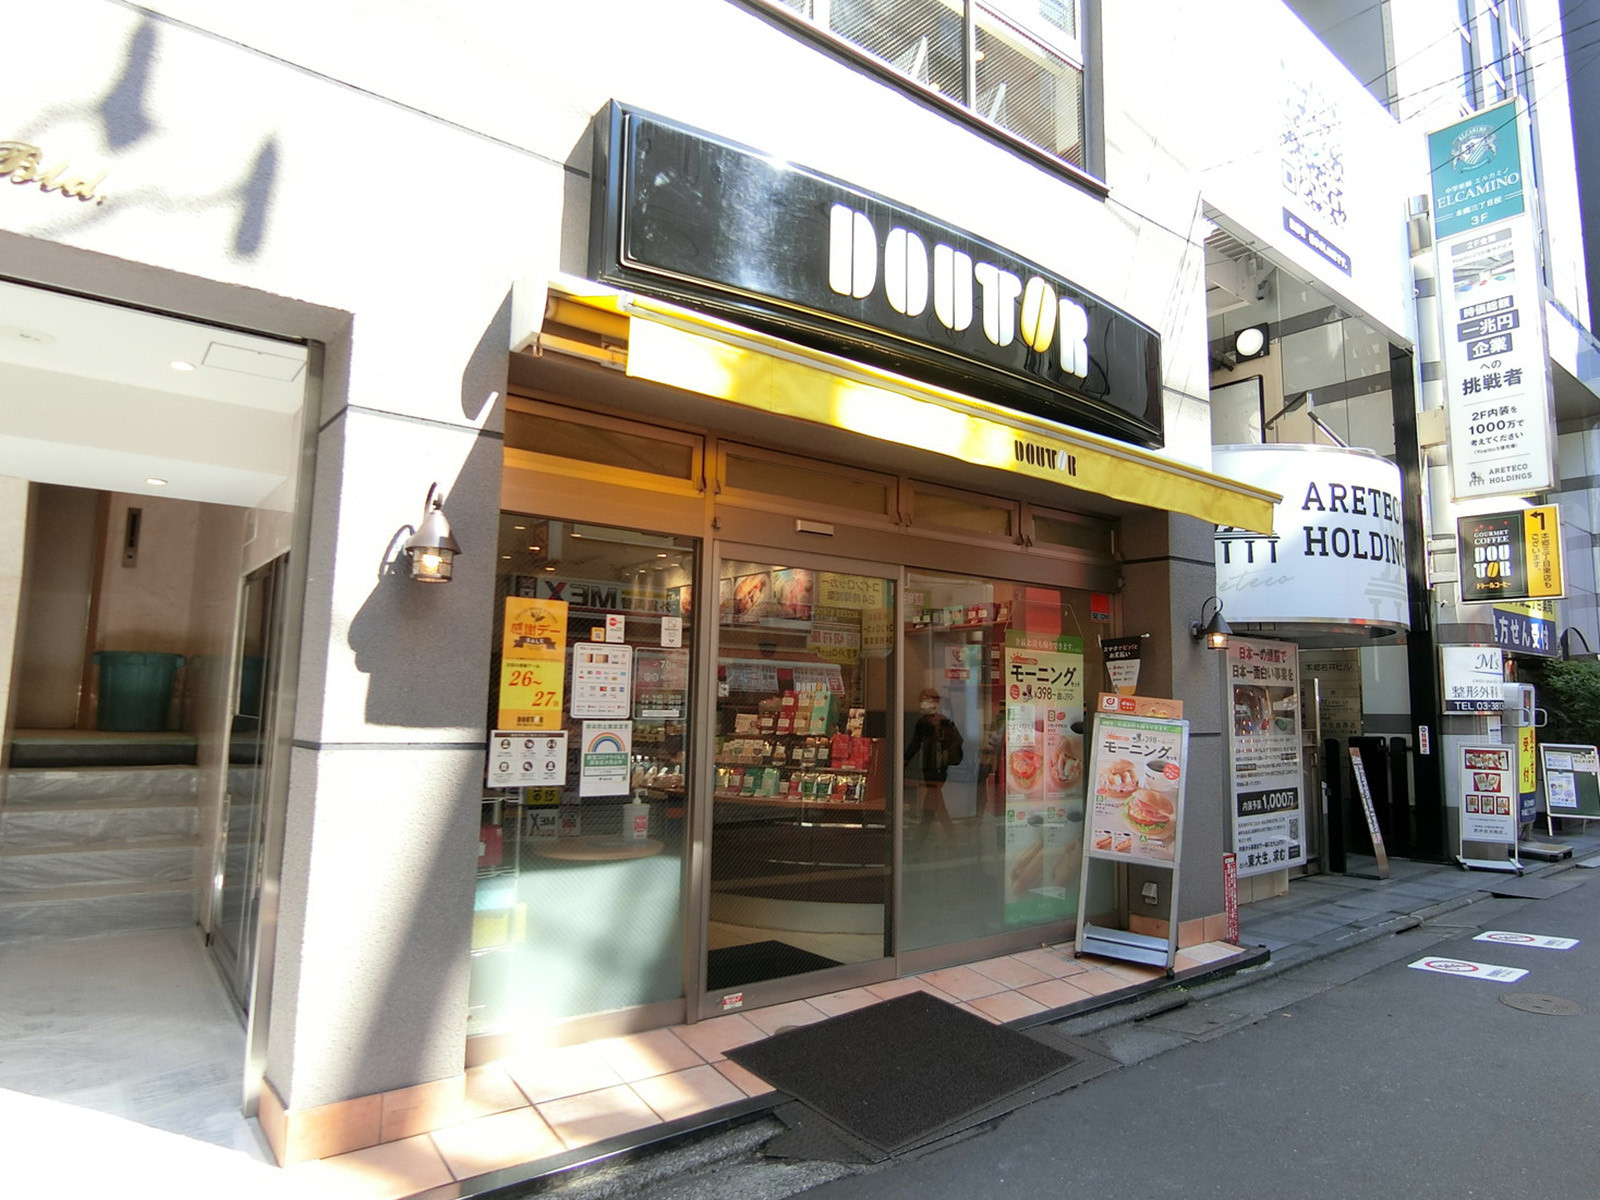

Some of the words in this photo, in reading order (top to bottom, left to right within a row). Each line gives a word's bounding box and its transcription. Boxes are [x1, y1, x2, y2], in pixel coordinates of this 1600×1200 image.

[1437, 172, 1519, 208] ELCAMINO
[1470, 212, 1488, 226] 3F
[829, 201, 1090, 379] DOUTOR
[1462, 313, 1514, 336] 一兆円
[1472, 336, 1508, 358] 企業
[1480, 360, 1502, 370] への
[1462, 368, 1523, 396] 挑戦者
[1471, 405, 1518, 421] 2F内装を
[1469, 419, 1524, 435] 1000万で
[1470, 432, 1524, 447] 考えてください
[1014, 439, 1077, 477] DOUTOR
[1489, 463, 1528, 475] ARETECO
[1489, 472, 1533, 484] HOLDINGS
[1474, 529, 1509, 538] GOURMET
[1474, 536, 1510, 545] COFFEE
[1474, 544, 1511, 563] DOU
[1473, 561, 1512, 579] TOR
[1476, 581, 1512, 590] ドトールコーヒー
[511, 622, 561, 636] 感謝デー
[1475, 652, 1500, 670] M's
[1011, 664, 1077, 687] モーニング
[1232, 664, 1294, 682] 日本一面白い事業を
[1454, 702, 1475, 710] TEL
[1103, 741, 1172, 759] モーニング
